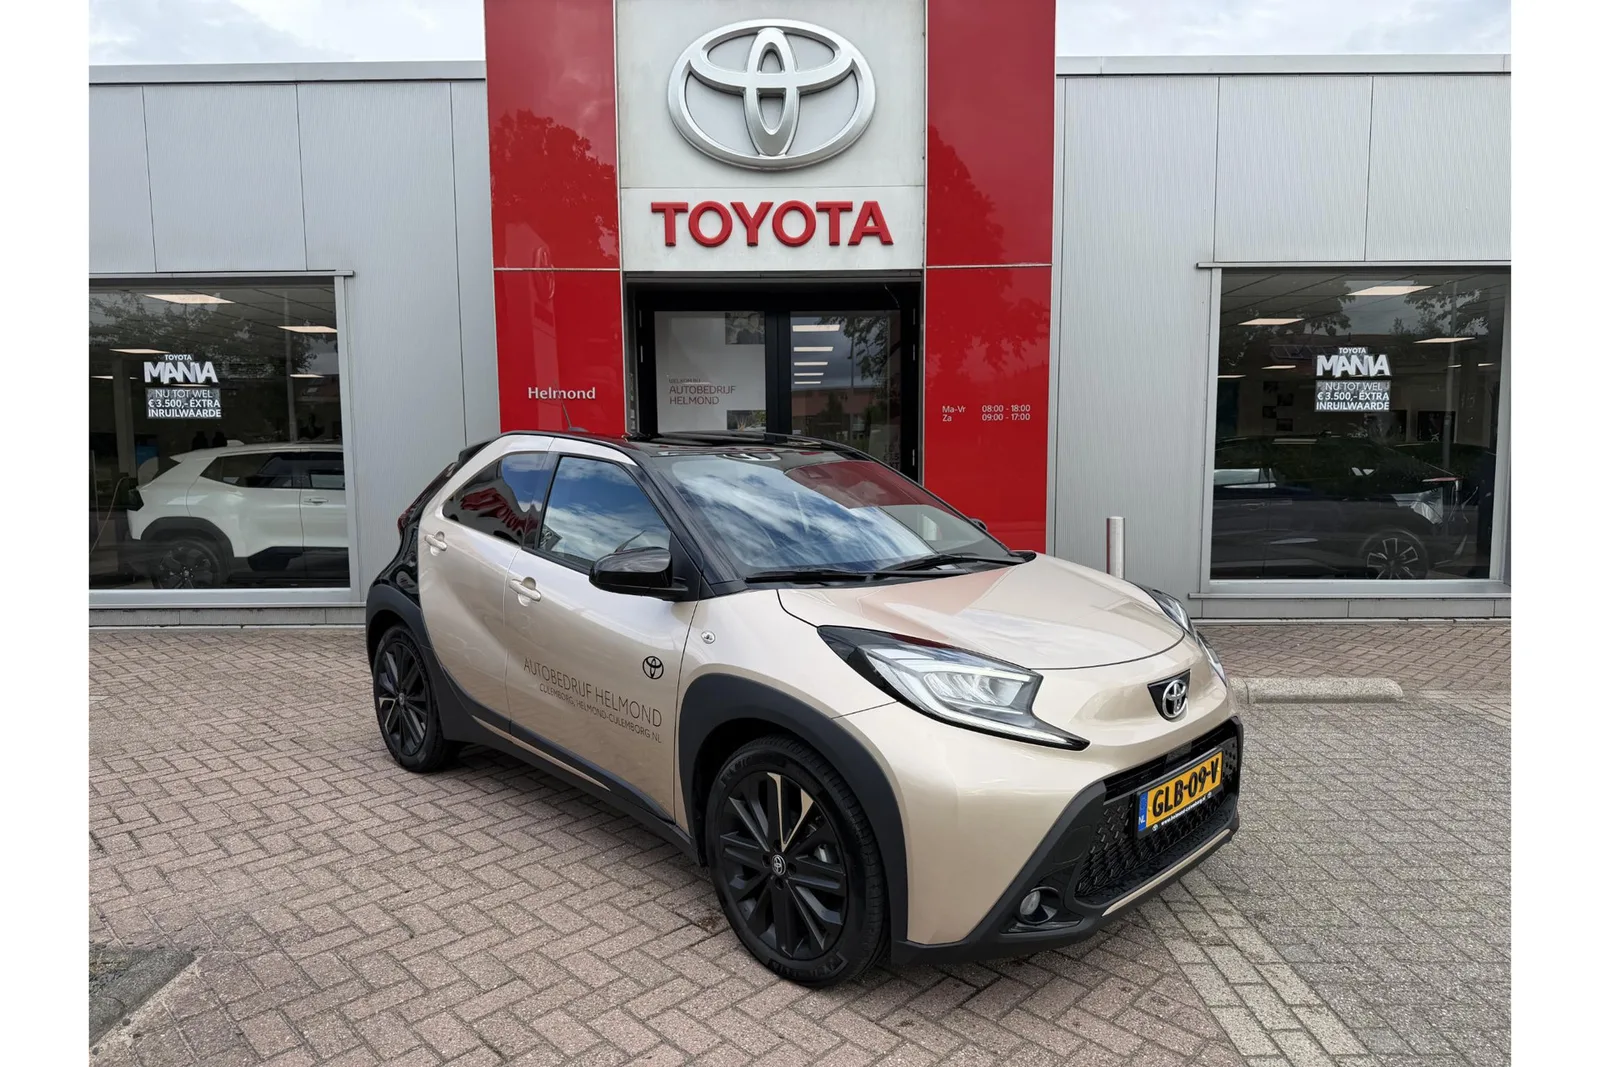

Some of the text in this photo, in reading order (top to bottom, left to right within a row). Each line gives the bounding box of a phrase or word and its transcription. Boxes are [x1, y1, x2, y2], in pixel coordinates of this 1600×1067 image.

[651, 200, 894, 247] TOYOTA
[1316, 354, 1391, 378] MANIA
[143, 361, 219, 384] MANIA
[669, 385, 736, 395] AUTOBEDRIJF
[1325, 382, 1382, 390] NU TOT WEL
[155, 390, 213, 398] NU TOT WEL
[528, 387, 596, 399] Helmond
[669, 396, 720, 405] HELMOND
[942, 405, 966, 413] Ma-Vr
[1011, 404, 1031, 412] 18:00
[1316, 402, 1390, 410] INRUILWAARDE
[148, 409, 222, 417] INRUILWAARDE
[942, 414, 952, 422] Za
[982, 413, 1004, 421] 09:00
[1011, 413, 1031, 421] 17:00
[524, 658, 662, 727] AUTOBEDRIJF HELMOND
[1152, 757, 1219, 817] GLB-09-V
[1138, 815, 1145, 824] NL
